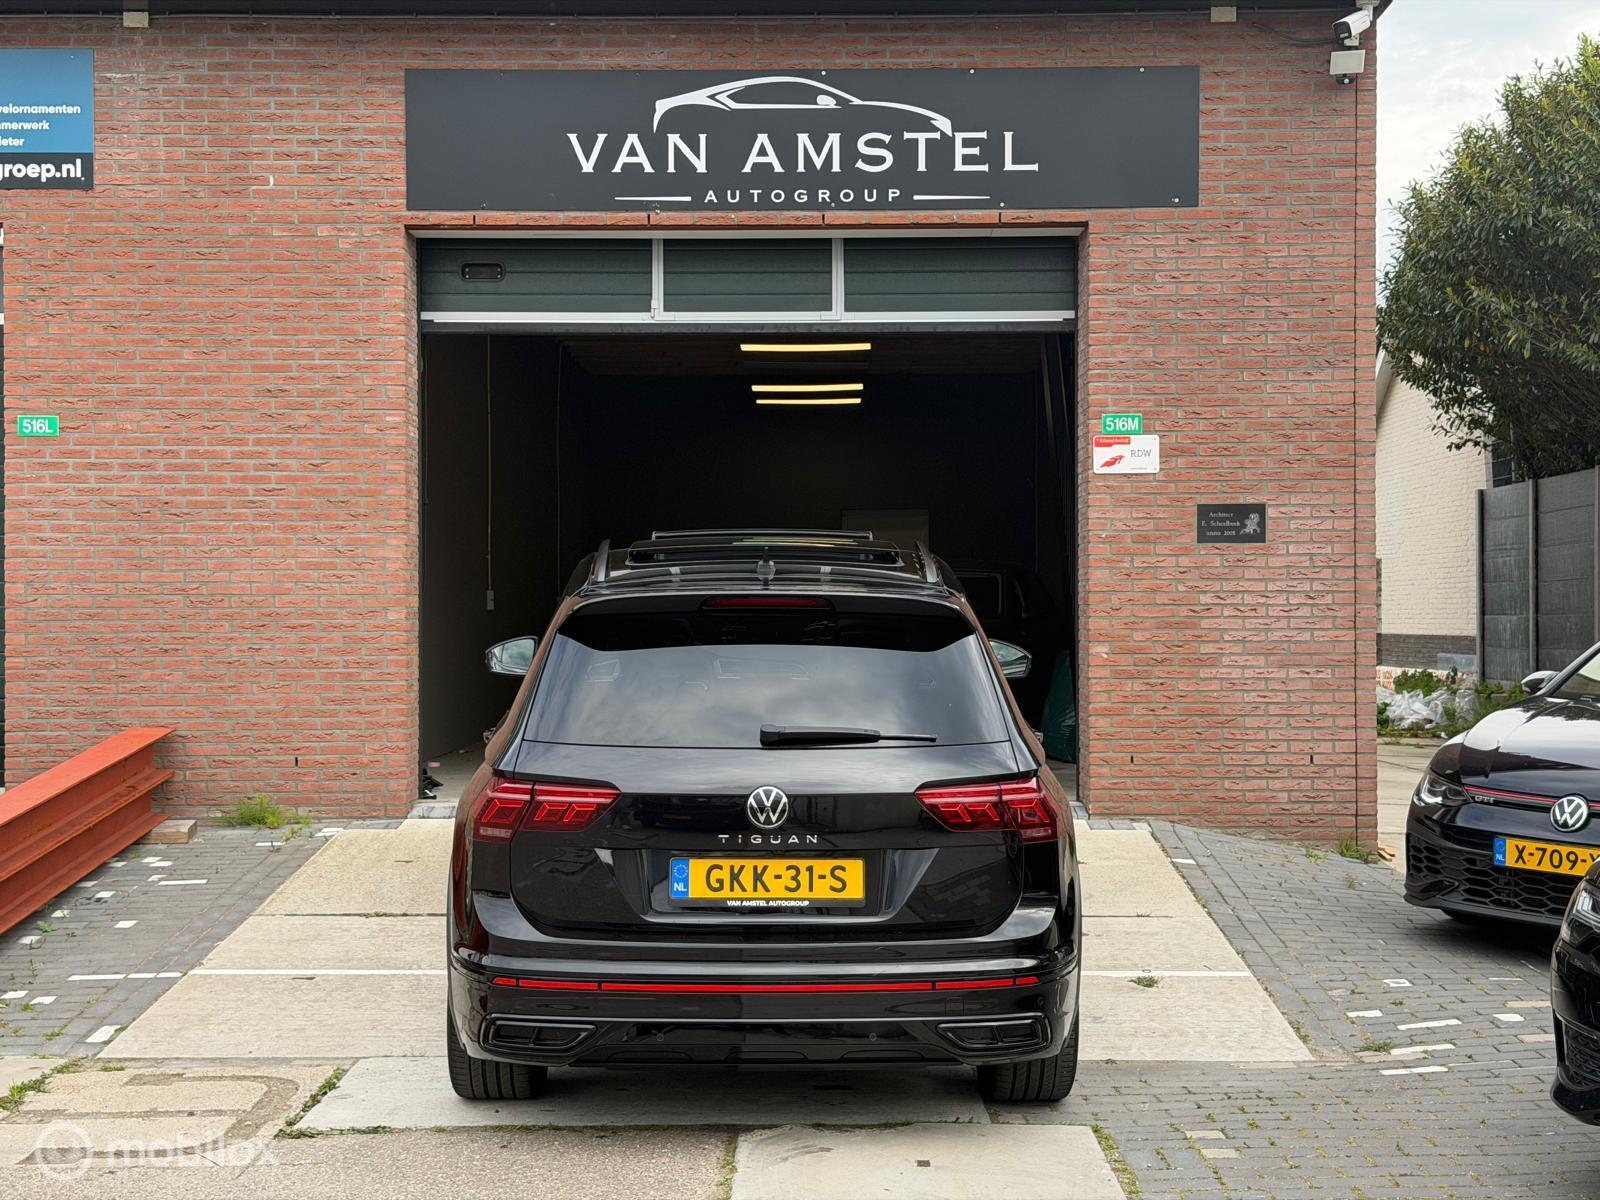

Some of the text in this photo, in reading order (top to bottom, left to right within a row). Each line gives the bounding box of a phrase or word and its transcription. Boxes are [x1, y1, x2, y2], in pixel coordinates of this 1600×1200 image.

[0, 119, 50, 130] merwerk
[566, 130, 1039, 174] VAN AMSTEL
[704, 188, 902, 204] AUTOGROUP
[22, 418, 54, 433] 516L
[1105, 417, 1140, 432] 516M
[1130, 449, 1152, 458] RDW
[717, 834, 818, 844] TIGUAN
[1495, 853, 1505, 861] NL
[673, 864, 847, 893] NL GKK-31-S
